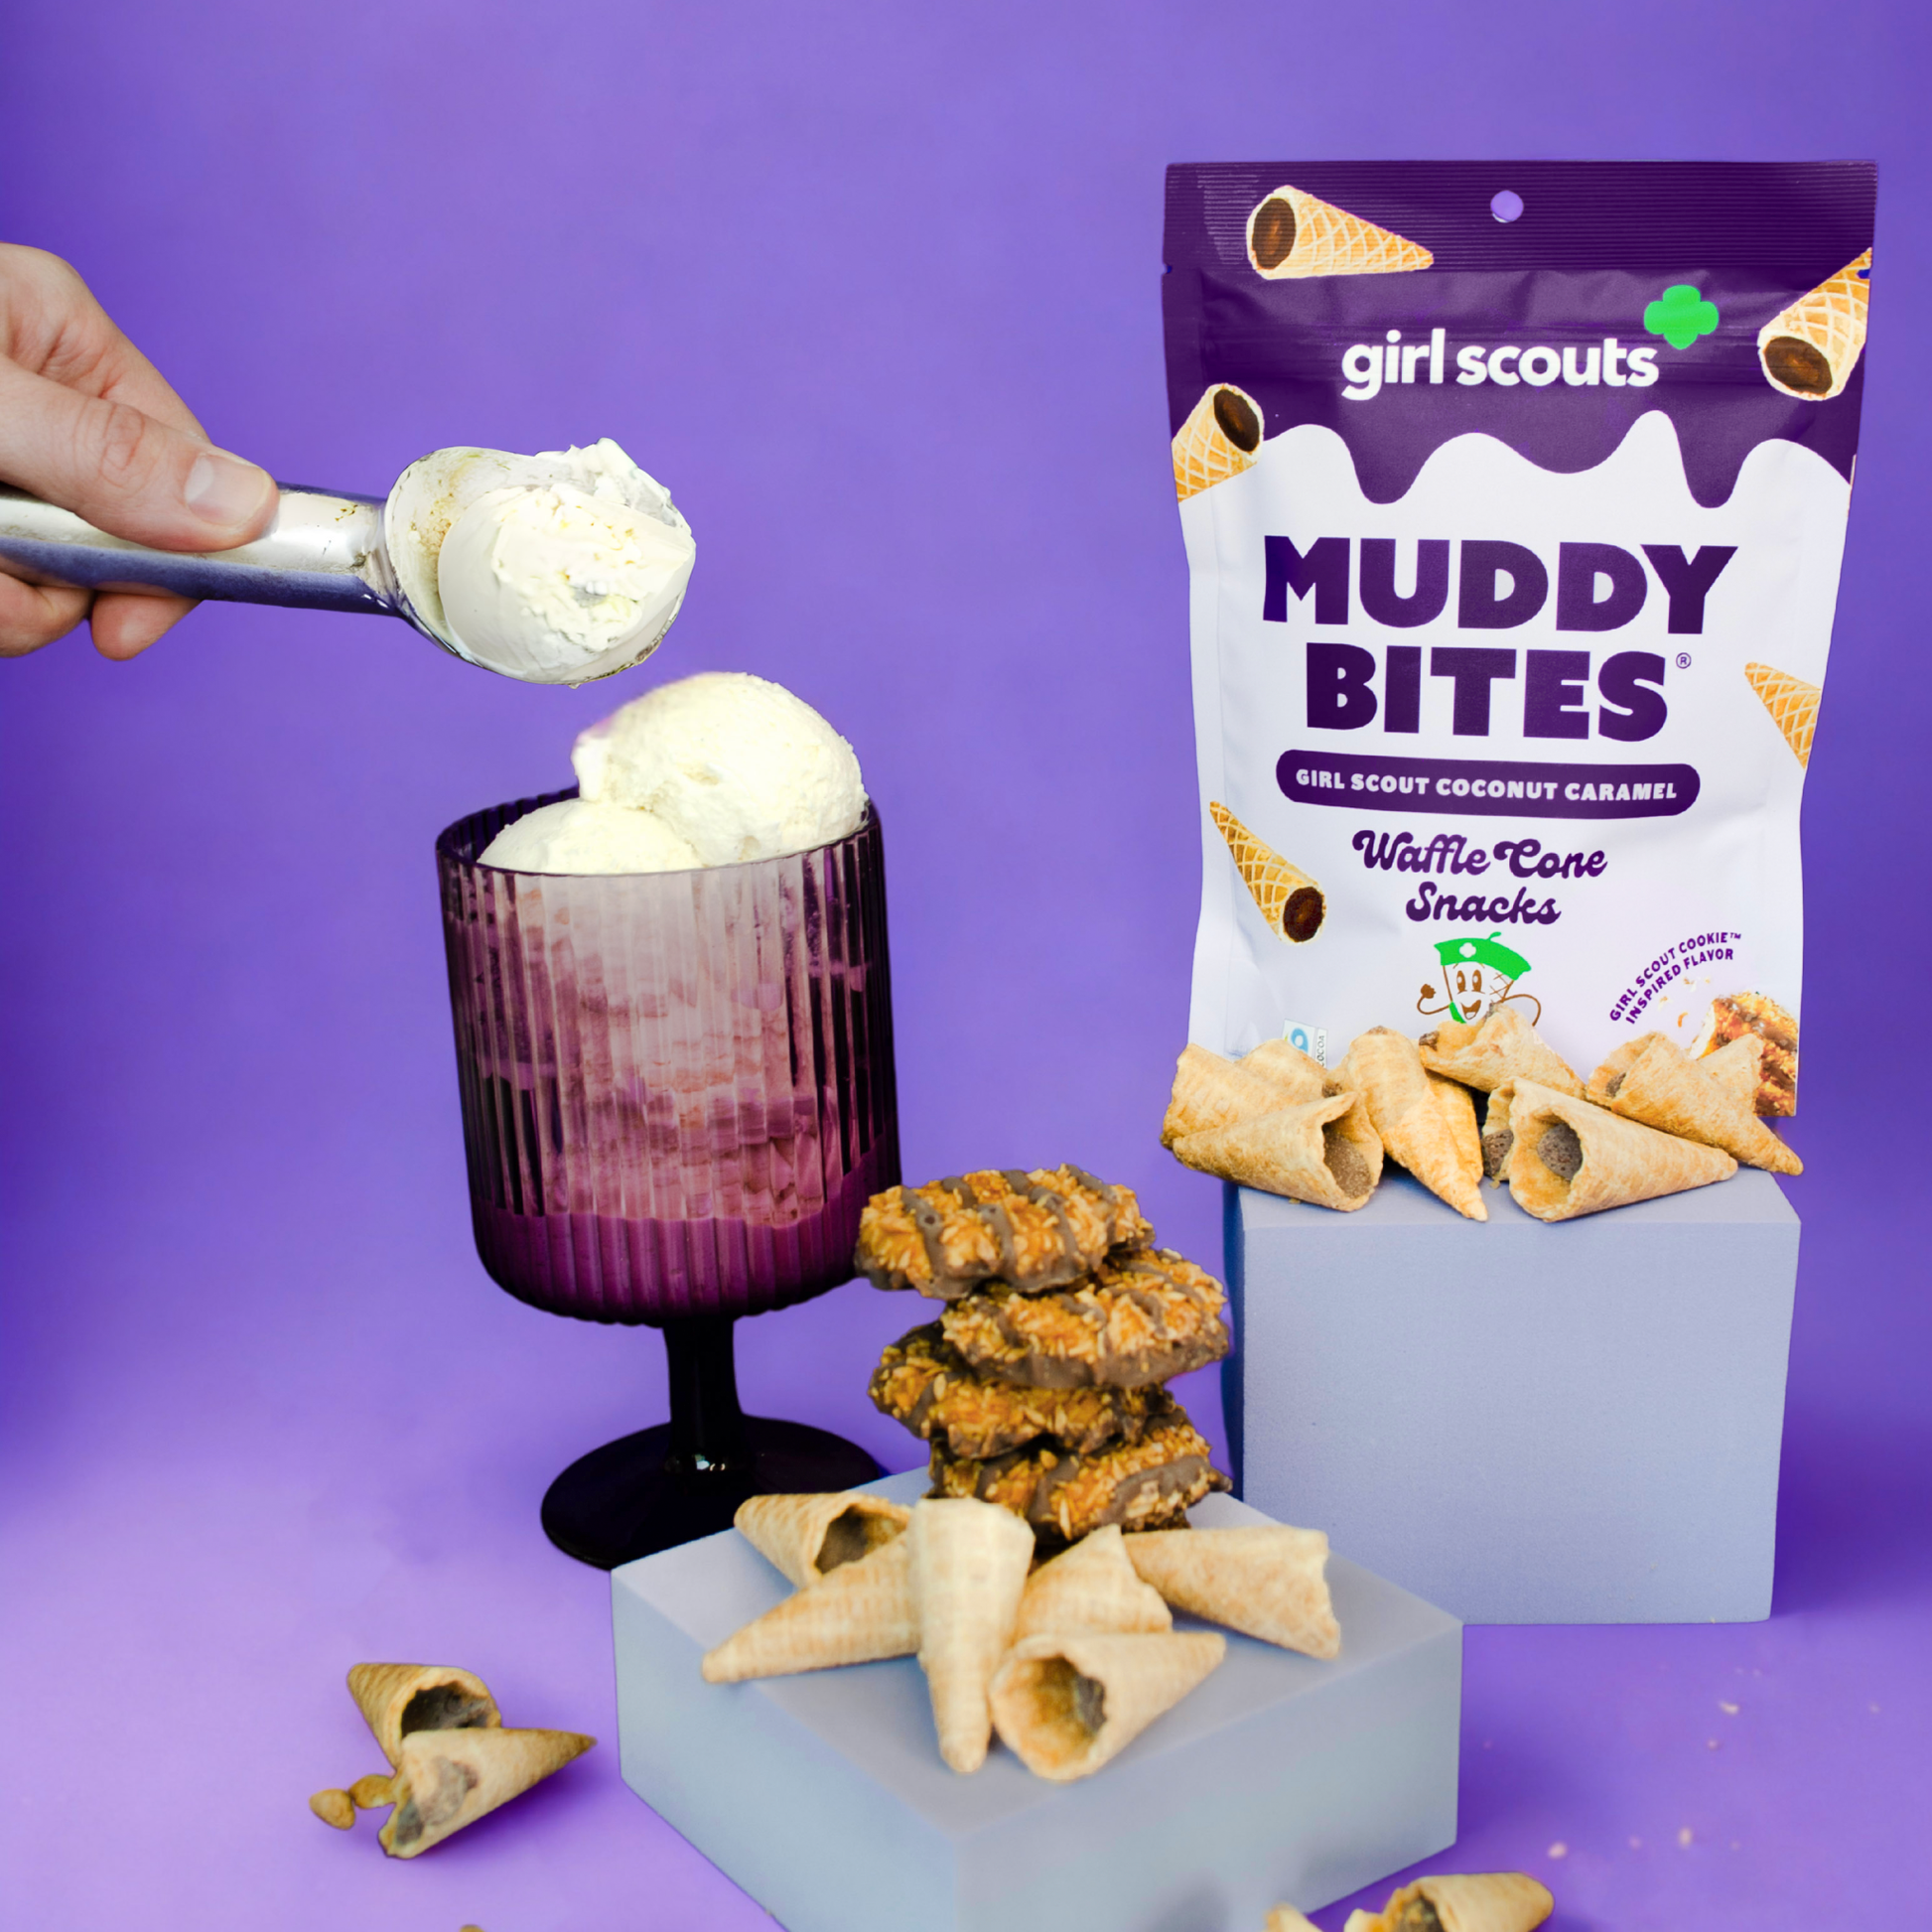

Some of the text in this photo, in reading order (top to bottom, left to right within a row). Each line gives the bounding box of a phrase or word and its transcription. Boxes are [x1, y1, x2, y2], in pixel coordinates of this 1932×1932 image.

[1341, 329, 1660, 401] girl scouts
[1263, 535, 1739, 635] MUDDY
[1296, 767, 1678, 803] GIRL SCOUT COCONUT CARAMEL
[1351, 829, 1608, 879] Waffle Cone
[1405, 881, 1562, 926] Snacks
[1609, 988, 1638, 1022] GIRL
[1635, 947, 1676, 988] SCOUT
[1625, 948, 1733, 1025] INSPIRED FLAVOR
[1316, 1035, 1325, 1067] OCOA
